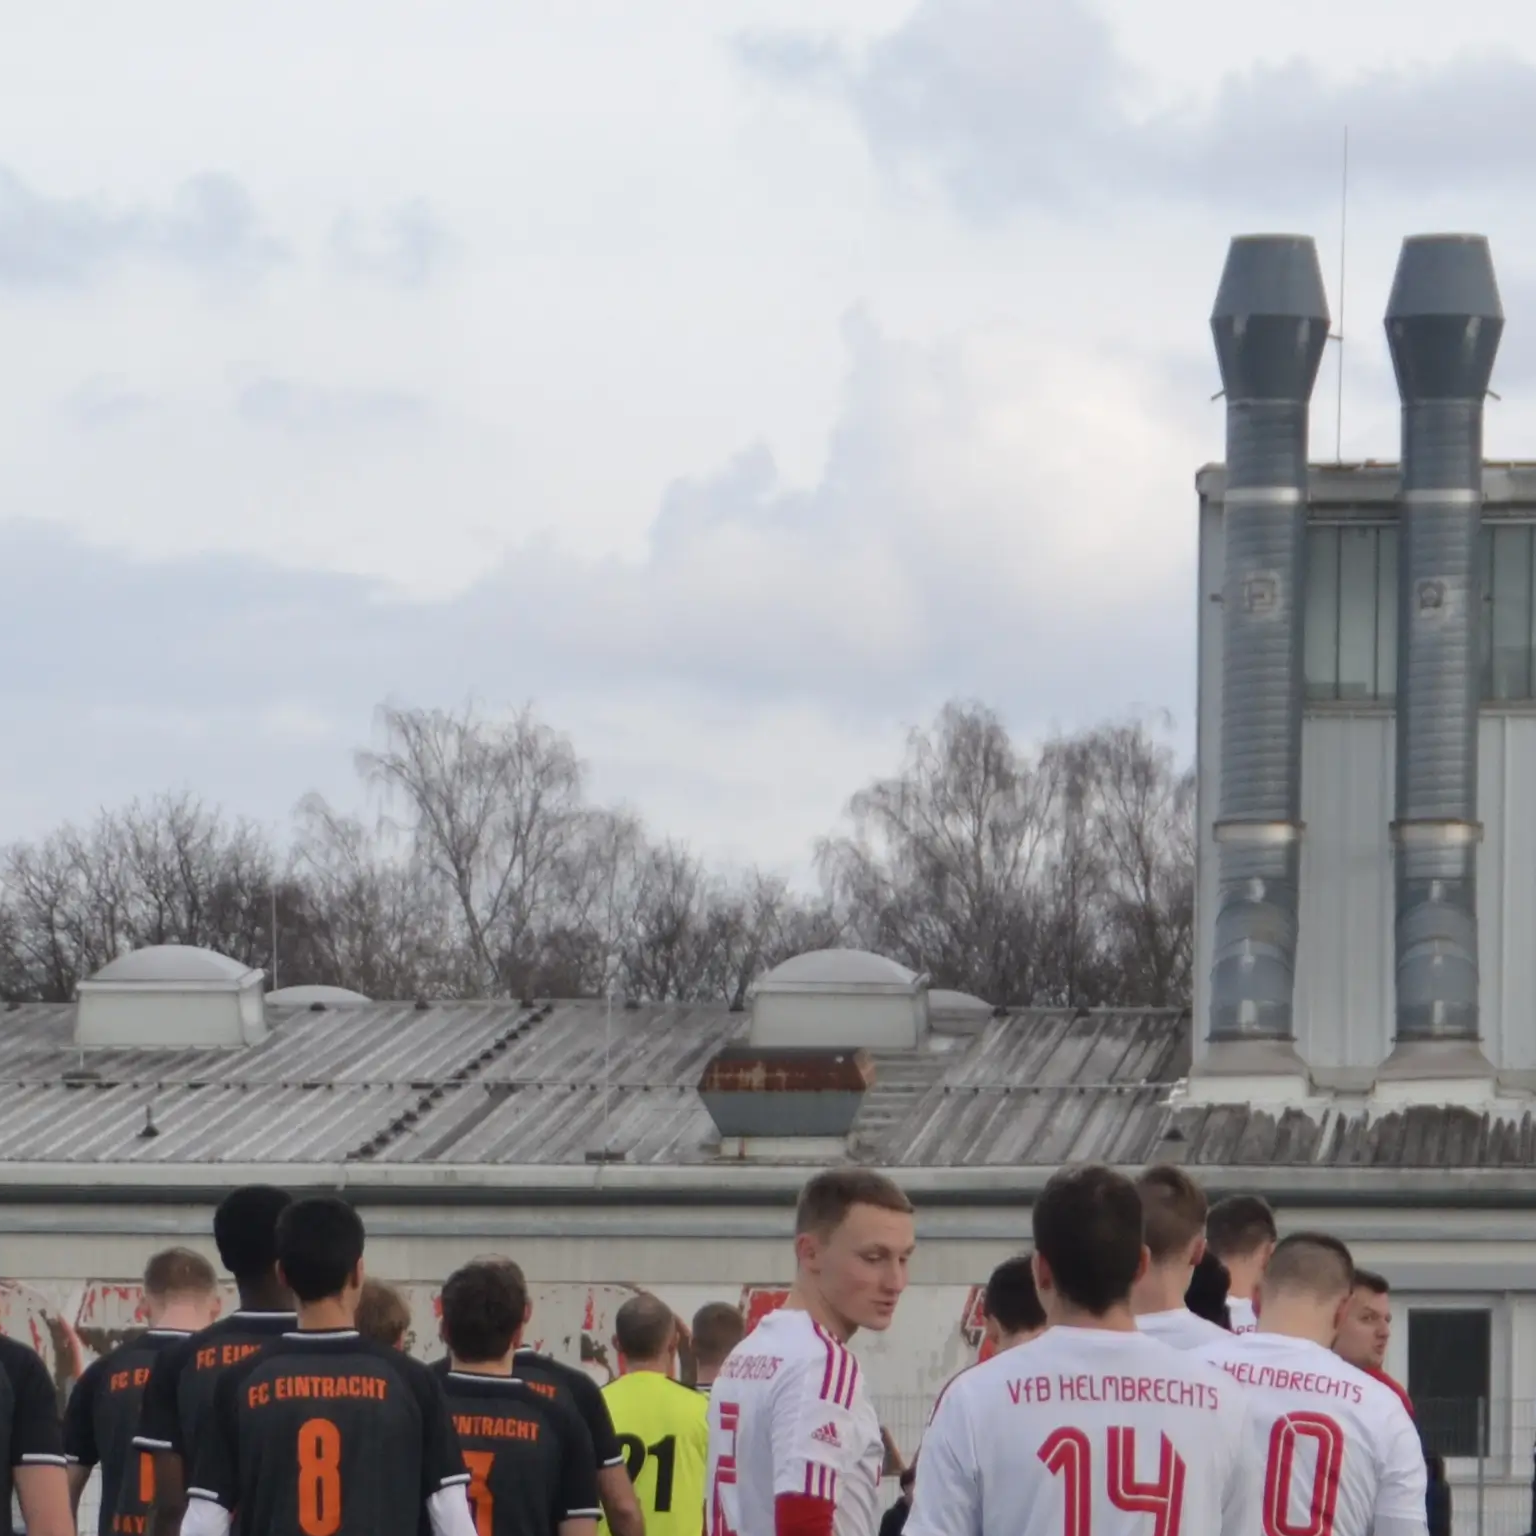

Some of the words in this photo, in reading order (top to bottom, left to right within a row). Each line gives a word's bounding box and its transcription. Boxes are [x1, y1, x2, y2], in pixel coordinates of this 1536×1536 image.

[193, 1349, 216, 1371] FC
[110, 1371, 129, 1394] FC
[248, 1383, 270, 1408] FC
[275, 1376, 387, 1400] EINTRACHT
[1007, 1376, 1052, 1405] VfB
[1059, 1374, 1218, 1410] HELMBRECHTS
[452, 1415, 539, 1441] NTRACHT
